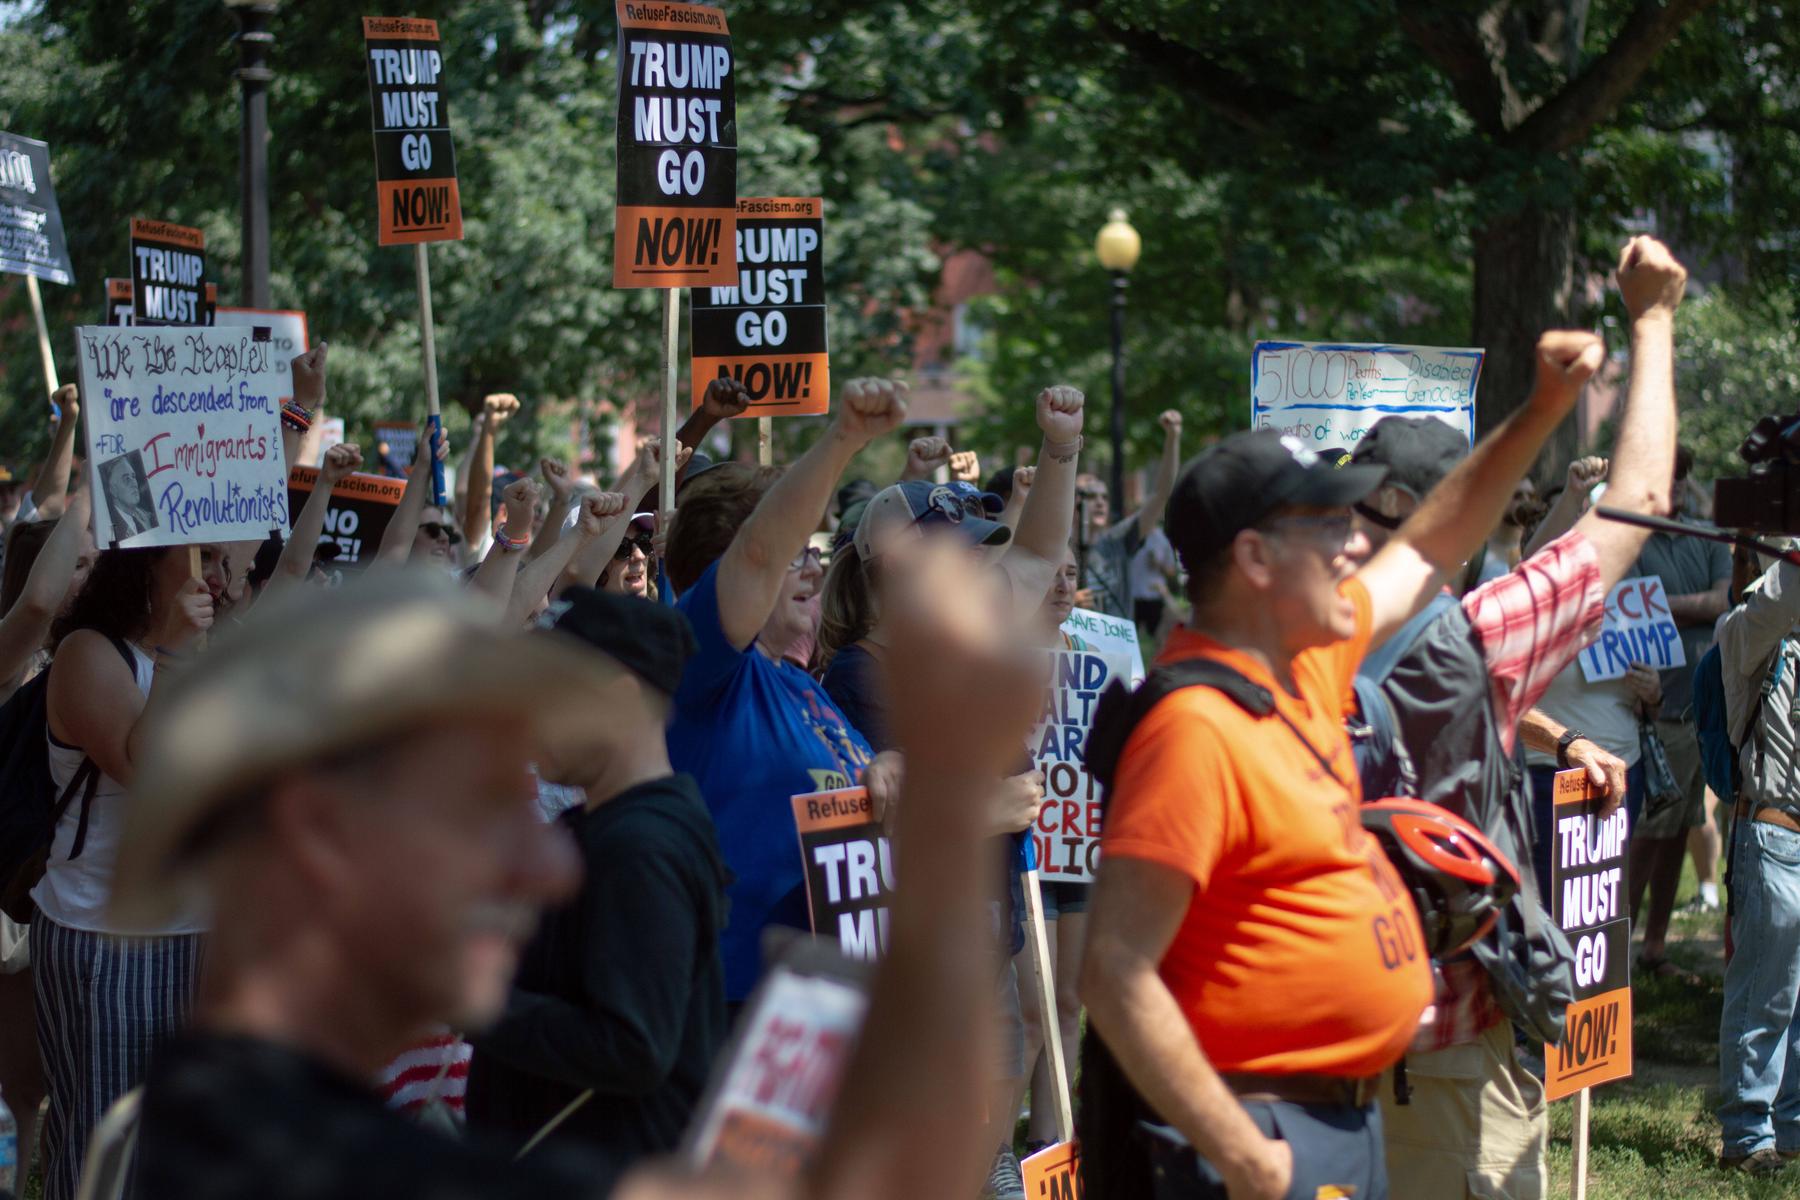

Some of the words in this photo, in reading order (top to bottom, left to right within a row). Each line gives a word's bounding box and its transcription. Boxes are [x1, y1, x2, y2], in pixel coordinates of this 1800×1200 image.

[625, 4, 721, 29] RefuseFascism.org
[370, 48, 441, 85] TRUMP
[630, 41, 730, 89] TRUMP
[382, 90, 438, 128] MUST
[634, 96, 721, 143] MUST
[401, 133, 432, 171] GO
[657, 149, 705, 196] GO
[393, 186, 450, 227] NOW!
[635, 216, 721, 267] NOW!
[136, 246, 203, 287] TRUMP
[711, 268, 807, 305] MUST
[145, 285, 198, 323] MUST
[735, 310, 788, 347] GO
[83, 333, 134, 381] We
[152, 384, 234, 415] descended
[239, 381, 273, 414] from
[1315, 418, 1331, 440] of
[1340, 426, 1370, 441] wor
[144, 423, 266, 480] Immigrants
[1101, 619, 1135, 643] DONE
[1588, 621, 1677, 674] TRUMP
[1038, 688, 1096, 726] ALT
[1029, 725, 1085, 762] AR
[1559, 775, 1586, 795] Refuse
[807, 795, 870, 820] Refuse
[1033, 799, 1102, 838] CRE
[1558, 807, 1628, 868] TRUMP
[814, 837, 895, 904] TRU
[1562, 867, 1621, 929] MUST
[1373, 906, 1415, 970] GO
[1575, 931, 1606, 987] GO
[1558, 1001, 1619, 1072] NOW!
